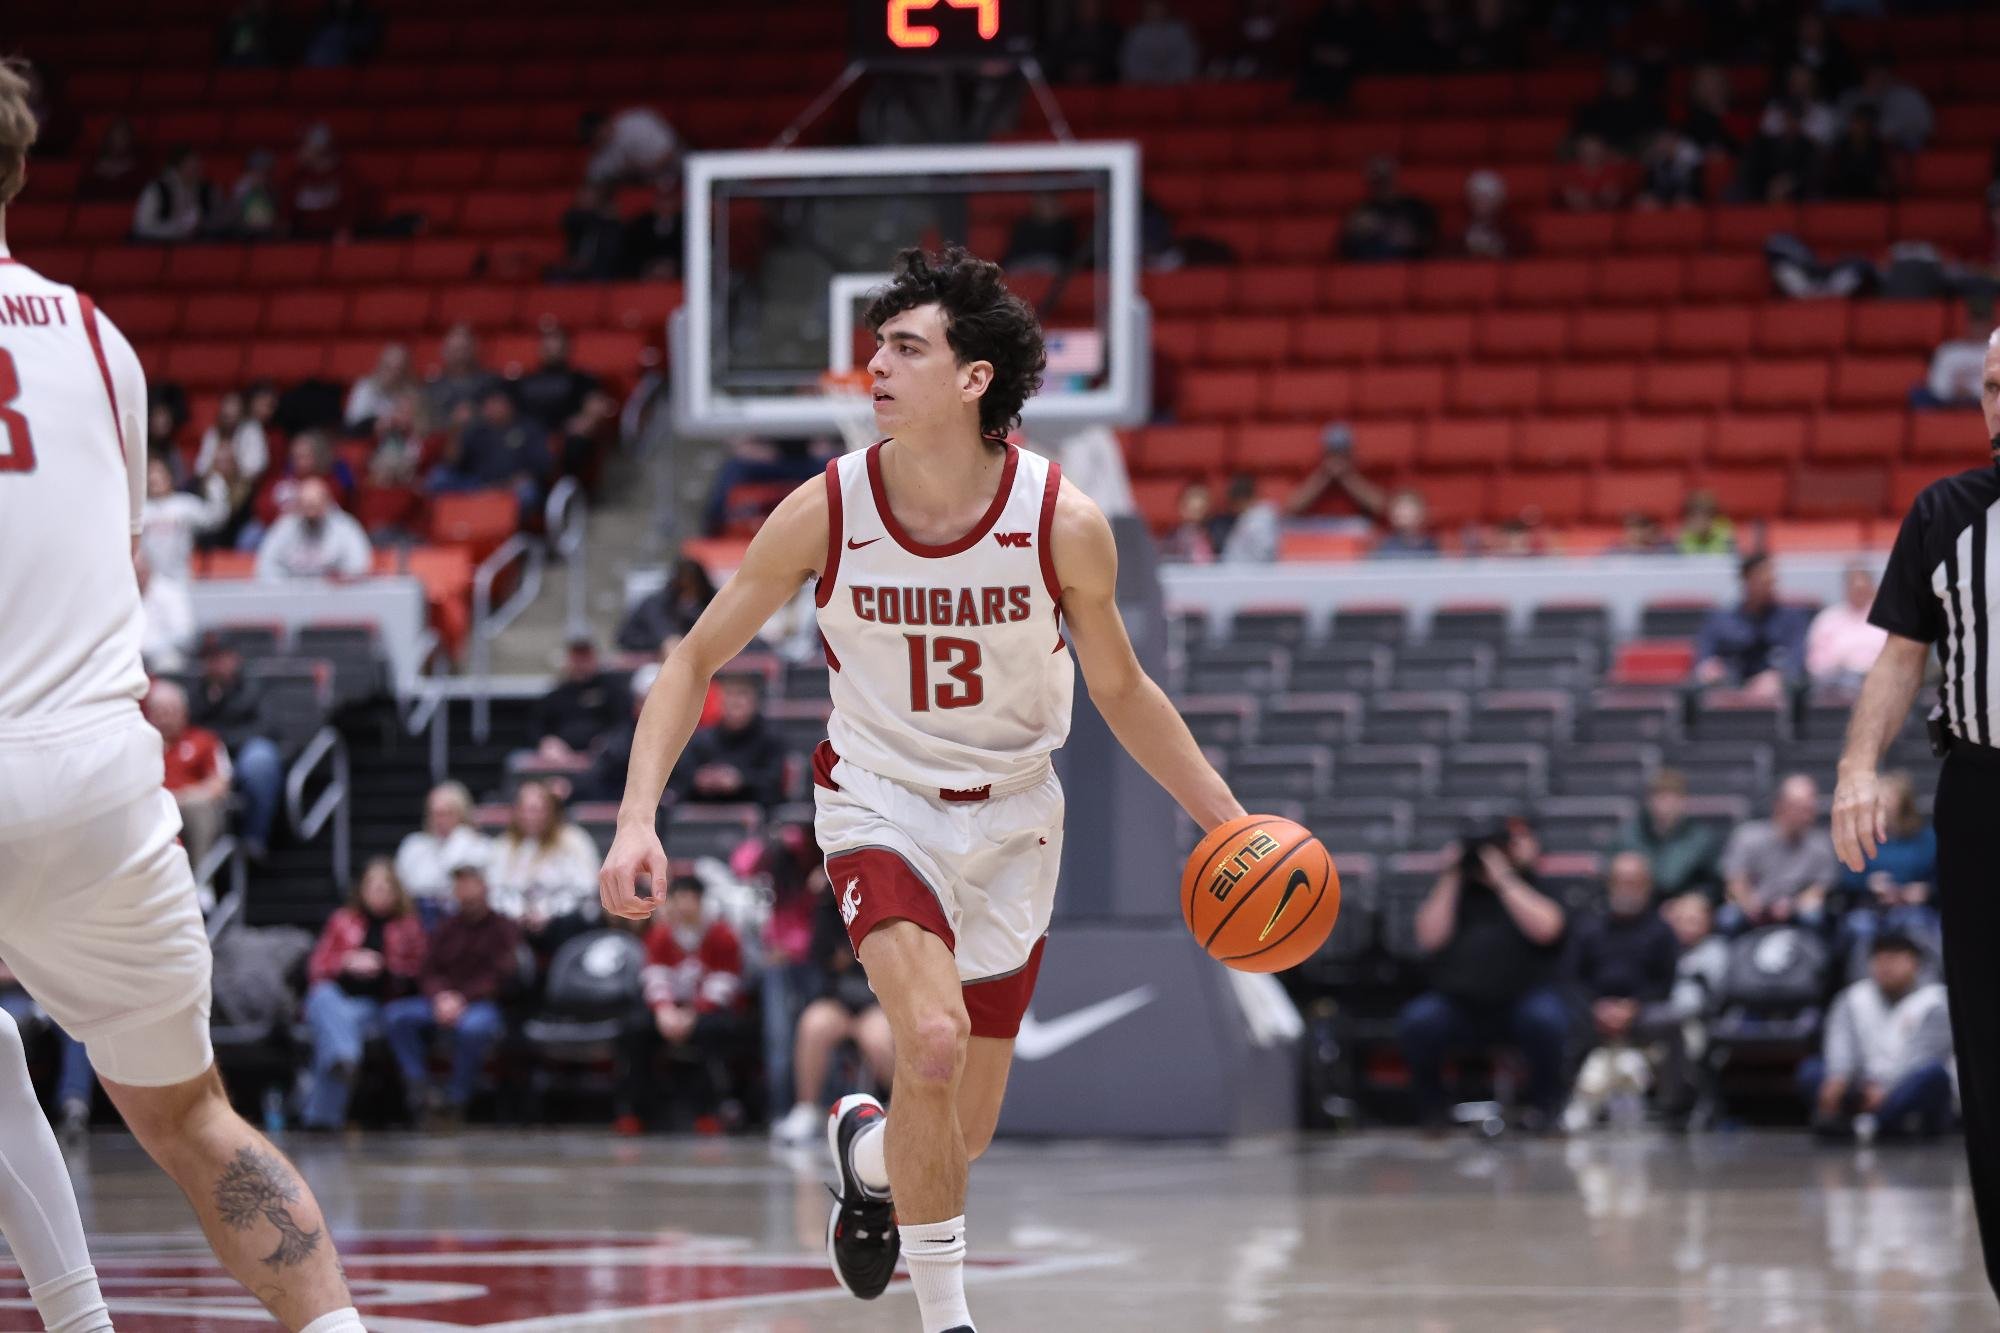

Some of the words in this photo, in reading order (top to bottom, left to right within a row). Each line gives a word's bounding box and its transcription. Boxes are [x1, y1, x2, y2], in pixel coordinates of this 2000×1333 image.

[849, 585, 1031, 626] COUGARS
[903, 633, 984, 712] 13
[1208, 832, 1281, 903] ELITE
